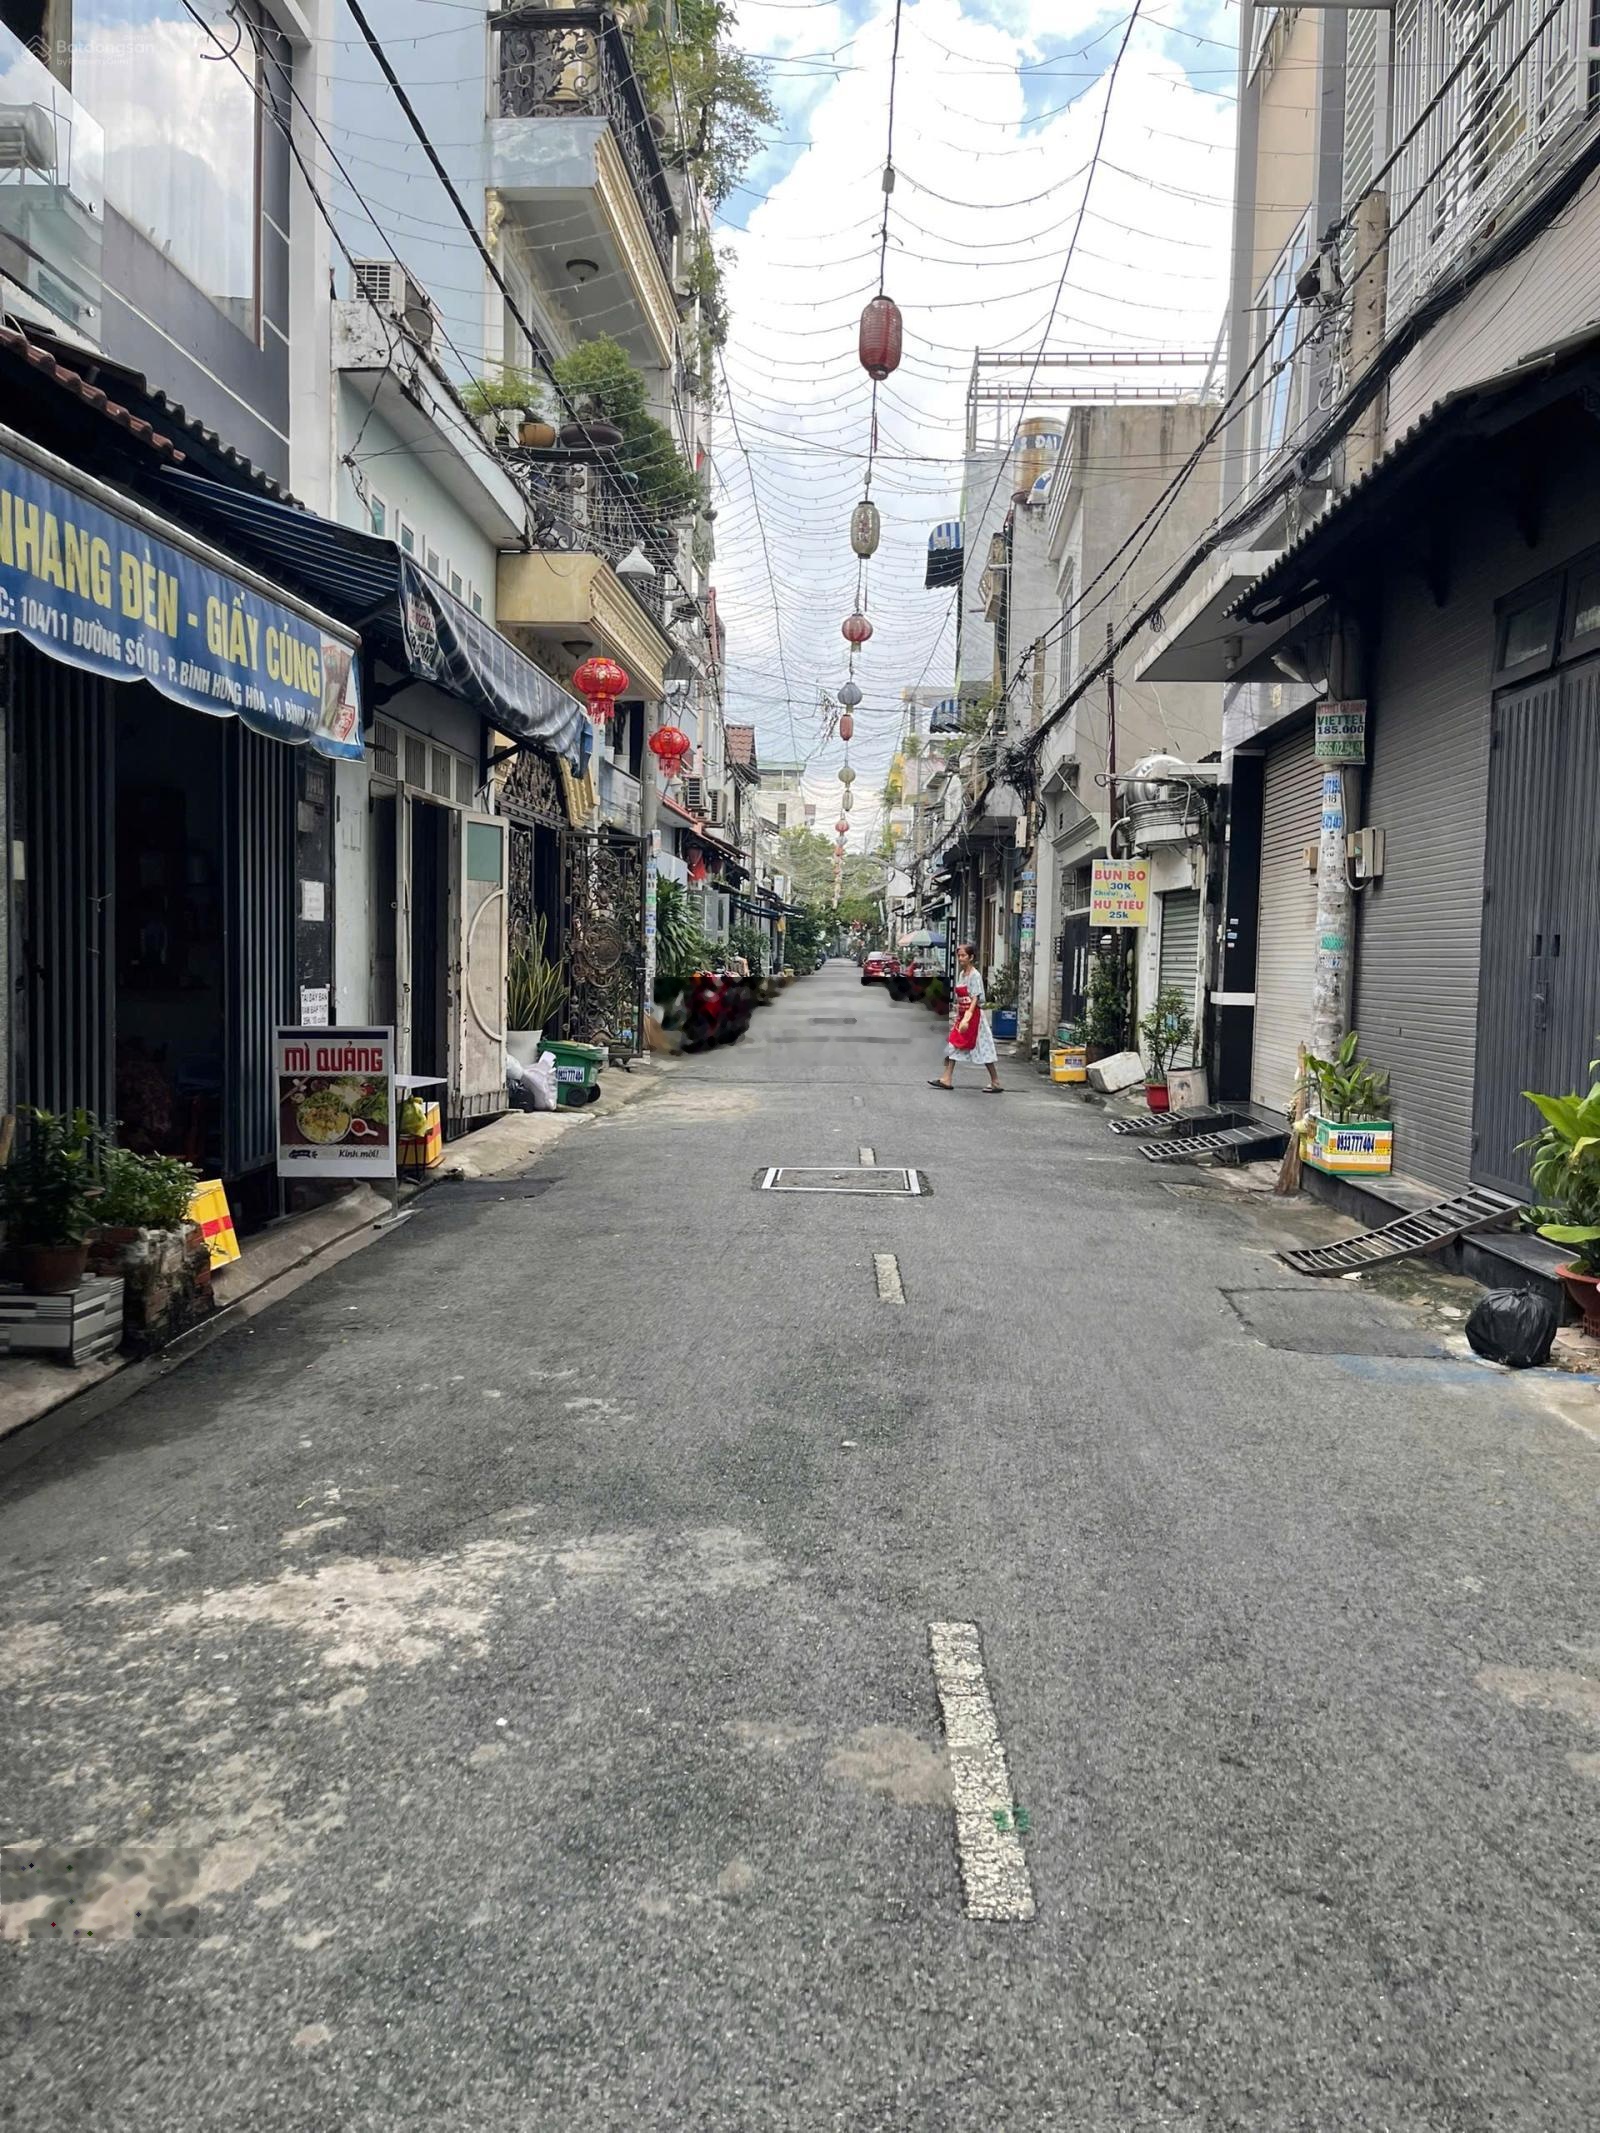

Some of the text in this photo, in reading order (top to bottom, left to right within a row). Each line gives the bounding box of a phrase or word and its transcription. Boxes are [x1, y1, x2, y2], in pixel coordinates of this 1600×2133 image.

[119, 547, 179, 639] ĐÈN
[206, 591, 259, 671] GIẤY
[265, 622, 321, 698] CÚNG
[20, 595, 68, 641] 104/11
[73, 616, 122, 660] ĐƯỜNG
[125, 633, 145, 668] SỐ
[147, 648, 160, 675] 18
[168, 656, 178, 682] P.
[180, 658, 211, 694] BÌNH
[211, 673, 243, 706] HƯNG
[244, 682, 267, 714] HÒA
[274, 697, 284, 721] Q.
[1317, 714, 1365, 725] VIETTEL
[1317, 725, 1364, 734] 185.000
[1110, 882, 1131, 890] 30K
[284, 1040, 383, 1072] MÌ QUẢNG
